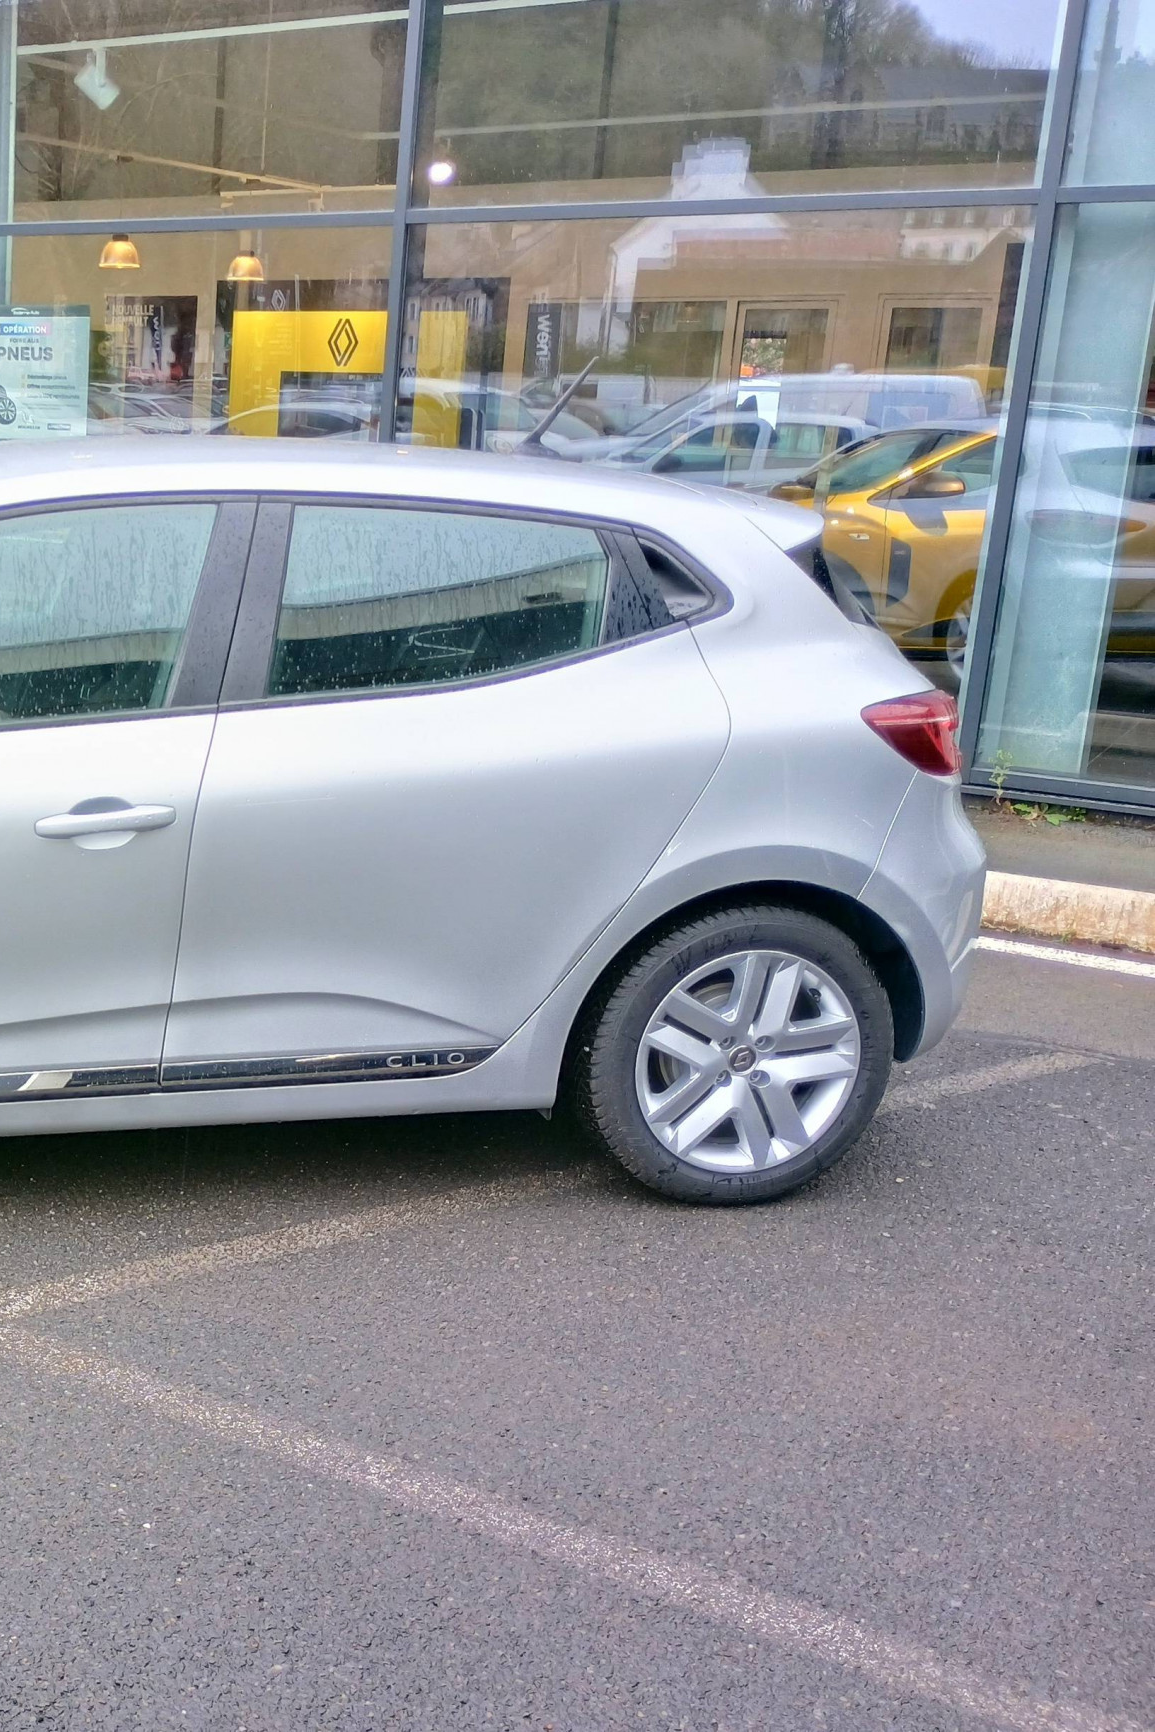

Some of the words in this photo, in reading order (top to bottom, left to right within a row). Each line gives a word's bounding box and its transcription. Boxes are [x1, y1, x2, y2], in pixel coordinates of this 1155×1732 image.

[112, 304, 155, 316] NOUVELLE
[2, 324, 47, 334] OPÉRATION
[386, 1052, 465, 1068] CLIO
